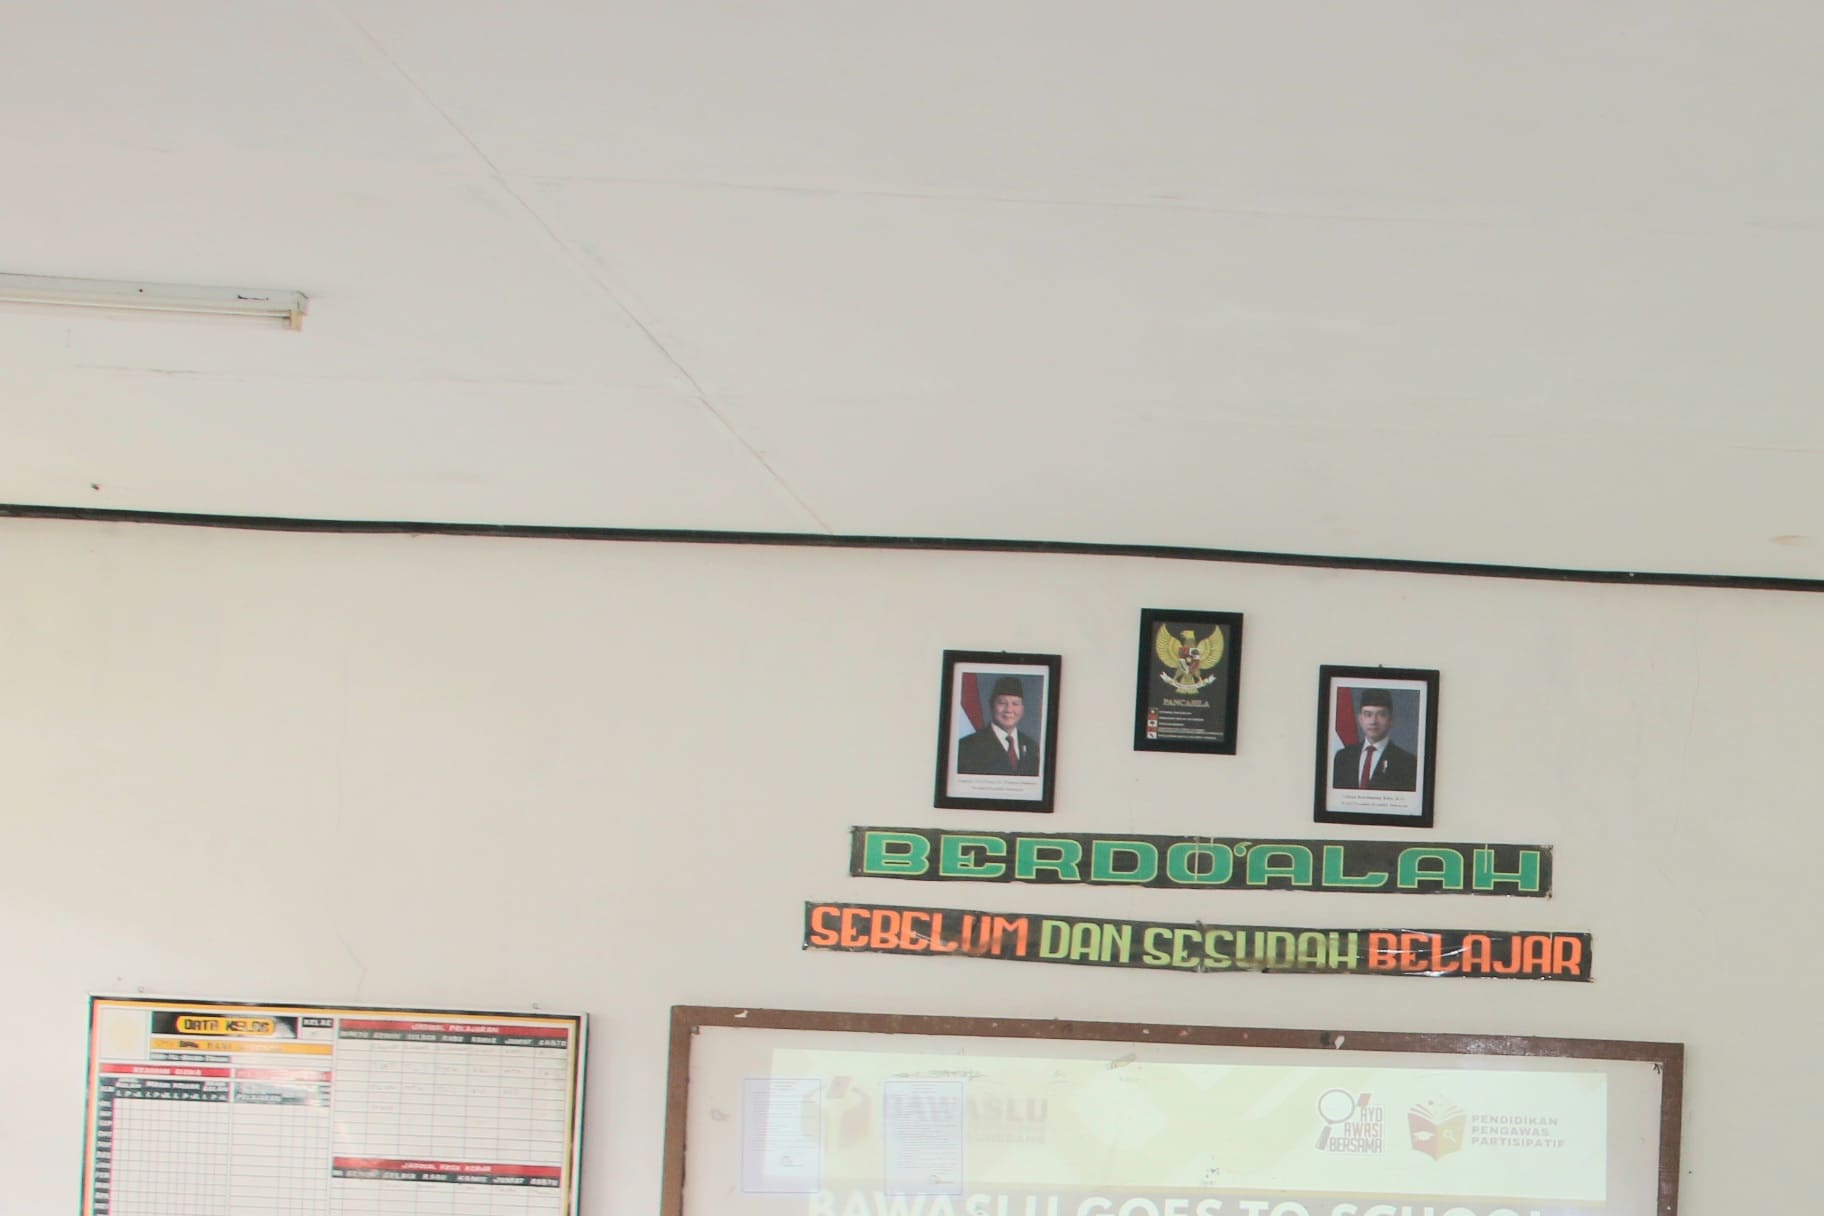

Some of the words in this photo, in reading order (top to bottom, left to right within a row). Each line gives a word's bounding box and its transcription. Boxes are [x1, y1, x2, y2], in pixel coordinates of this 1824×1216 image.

[809, 905, 1028, 957] SEBELUM
[1039, 919, 1133, 963] DAN
[1142, 925, 1359, 970] SESUDAH
[1367, 932, 1584, 976] BELAJAR
[1360, 1107, 1384, 1122] AYO
[1471, 1114, 1560, 1126] PENDIDIKAN
[1343, 1122, 1384, 1138] AWASI
[1471, 1125, 1551, 1137] PENGAWAS
[1328, 1137, 1384, 1153] BERSAMA
[1471, 1136, 1567, 1149] PARTISIPATIF
